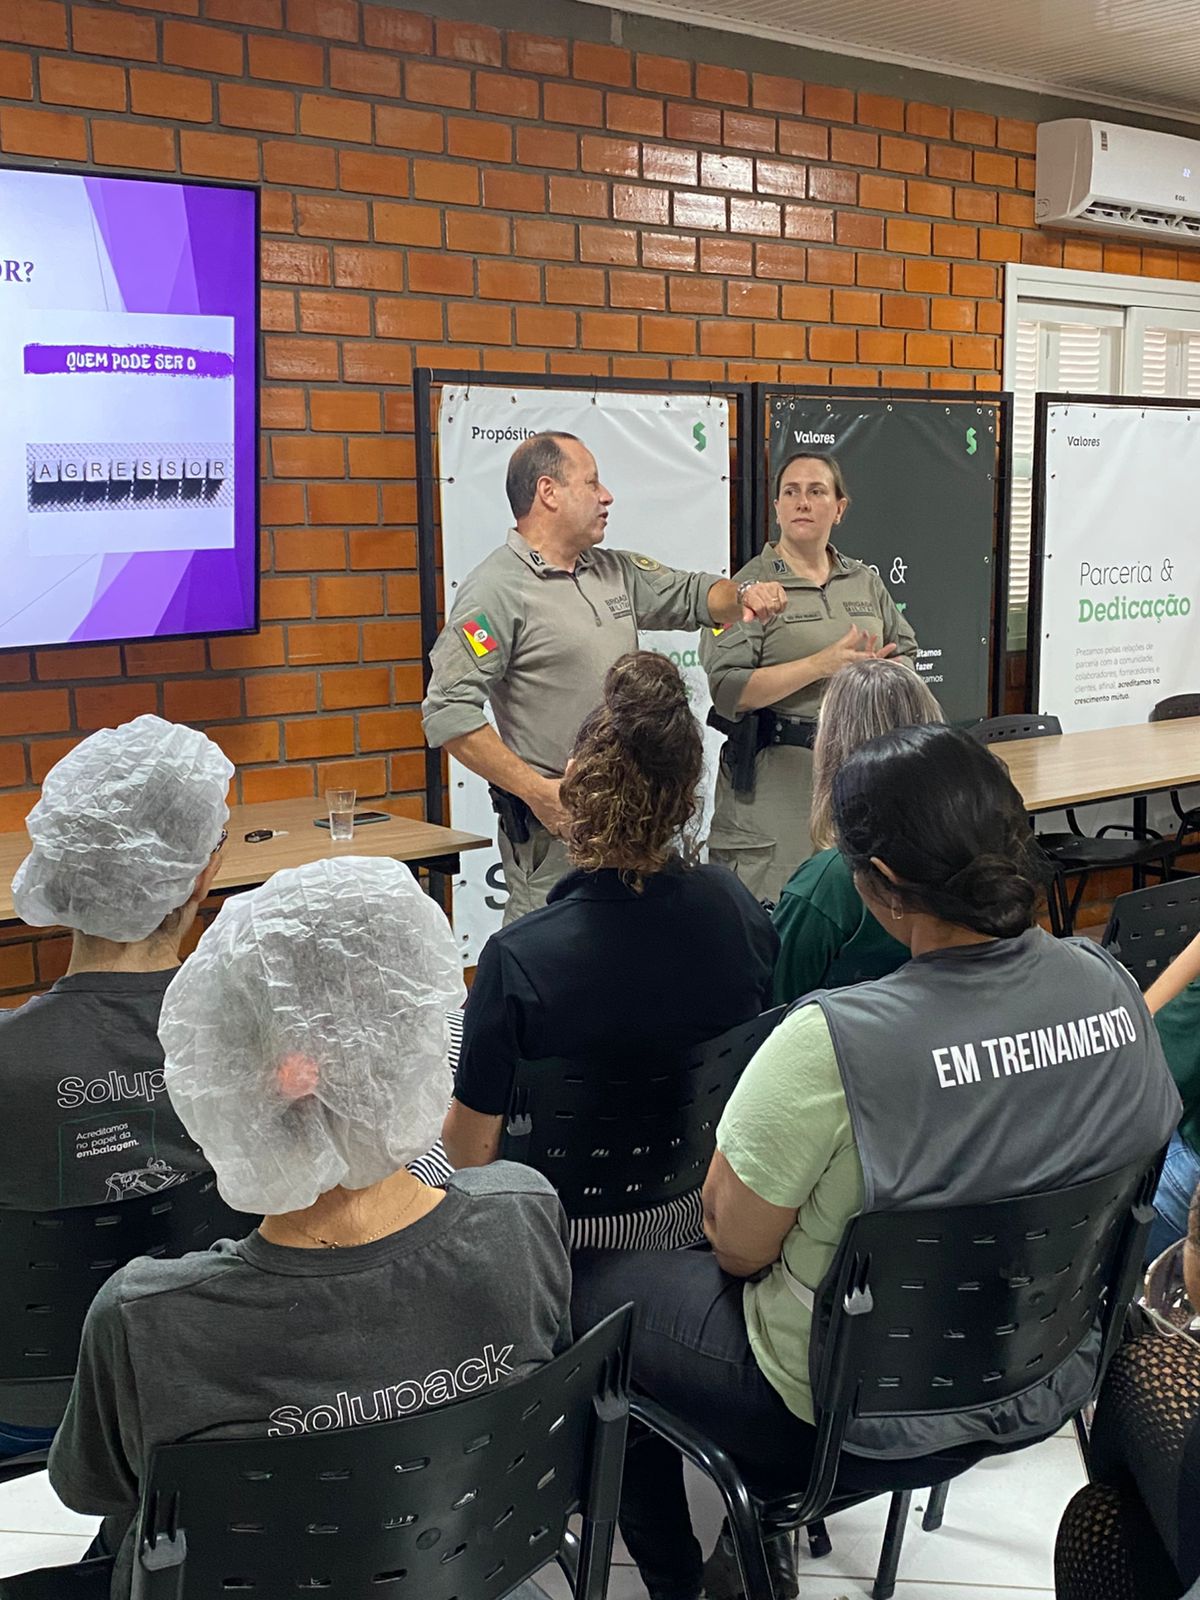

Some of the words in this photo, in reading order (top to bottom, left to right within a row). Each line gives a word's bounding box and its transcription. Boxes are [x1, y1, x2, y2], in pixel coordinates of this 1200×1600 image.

[0, 259, 34, 282] R?
[66, 351, 108, 371] QUEM
[112, 352, 151, 369] PODE
[154, 354, 183, 369] SER
[187, 356, 196, 370] O
[794, 431, 835, 444] Valores
[1067, 436, 1100, 446] Valores
[39, 461, 225, 479] AGRESSOR
[890, 557, 908, 584] &
[1080, 560, 1152, 586] Parceria
[1160, 558, 1174, 582] &
[1079, 593, 1191, 623] Dedicação
[916, 662, 933, 671] fazer
[1118, 679, 1152, 688] acreditamos
[1074, 695, 1109, 705] crescimento
[932, 1043, 981, 1088] EM
[981, 1006, 1137, 1078] TREINAMENTO
[57, 1069, 167, 1108] Solup
[76, 1123, 129, 1140] Acreditamos
[76, 1142, 88, 1150] no
[91, 1134, 117, 1148] papel
[119, 1131, 131, 1140] da
[76, 1139, 140, 1158] embalagem.
[268, 1343, 514, 1437] Solupack
